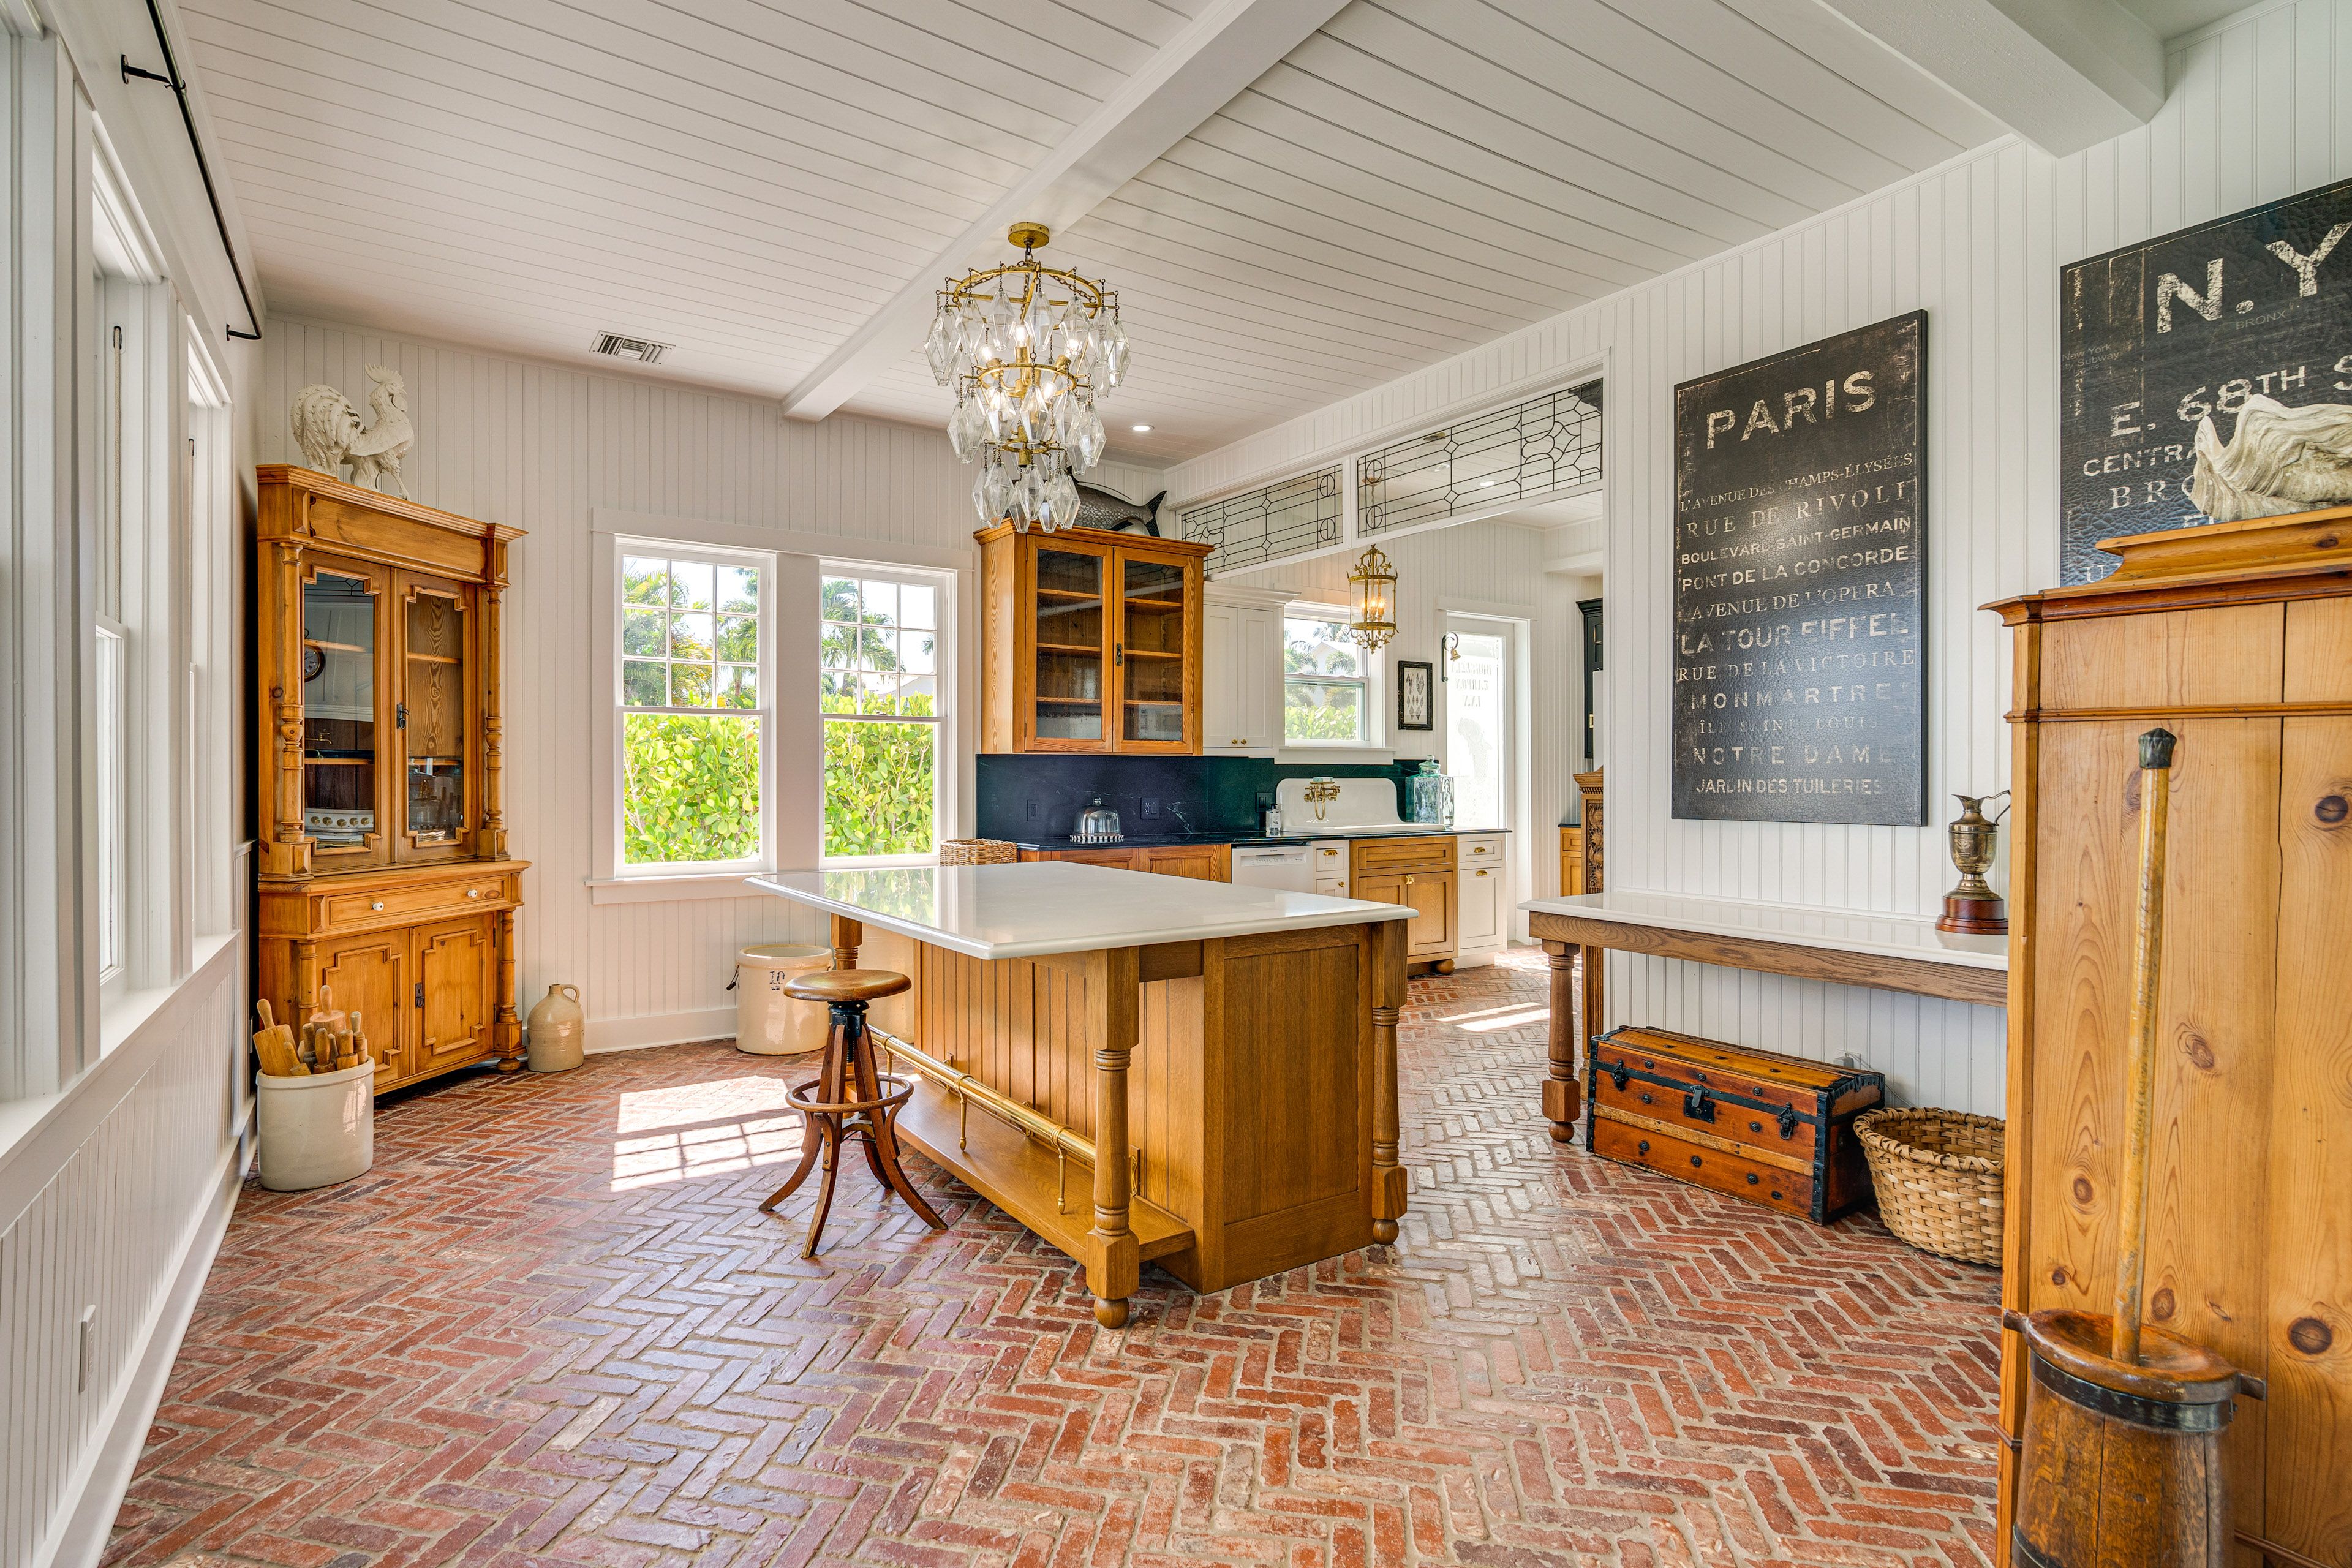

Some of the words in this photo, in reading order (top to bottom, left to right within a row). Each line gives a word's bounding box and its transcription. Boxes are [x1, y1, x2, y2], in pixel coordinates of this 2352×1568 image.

[2236, 309, 2286, 330] BRONX
[2062, 351, 2086, 361] New
[2088, 344, 2111, 355] York
[2078, 352, 2120, 367] Subway
[1706, 370, 1877, 450] PARIS
[2110, 400, 2156, 437] E.
[2176, 366, 2305, 421] 68TH
[1680, 489, 1746, 511] L'AVENUE
[1749, 487, 1775, 499] DES
[1687, 516, 1736, 538] RUE
[1751, 507, 1780, 527] DE
[1795, 481, 1905, 520] RIVOLI
[1681, 542, 1770, 565] BOULEVARD
[1777, 516, 1912, 550] SAINT-GERMAIN
[1682, 573, 1727, 592] PONT
[1732, 569, 1756, 585] DE
[1762, 565, 1789, 581] LA
[1794, 545, 1909, 576] CONCORDE
[1691, 598, 1768, 620] AVENUE
[1773, 593, 1800, 610] DE
[1681, 633, 1714, 656] LA
[1722, 624, 1792, 651] TOUR
[1801, 612, 1909, 641] EIFFEL
[1679, 666, 1717, 682] RUE
[1728, 662, 1754, 677] DE
[1762, 660, 1787, 676] LA
[1795, 649, 1915, 672] VICTOIRE
[1691, 682, 1891, 710] MONMARTRE
[1693, 746, 1785, 766] NOTRE
[1804, 743, 1892, 764] DAME
[1756, 778, 1788, 794] DES
[1792, 778, 1883, 795] TUILERIES
